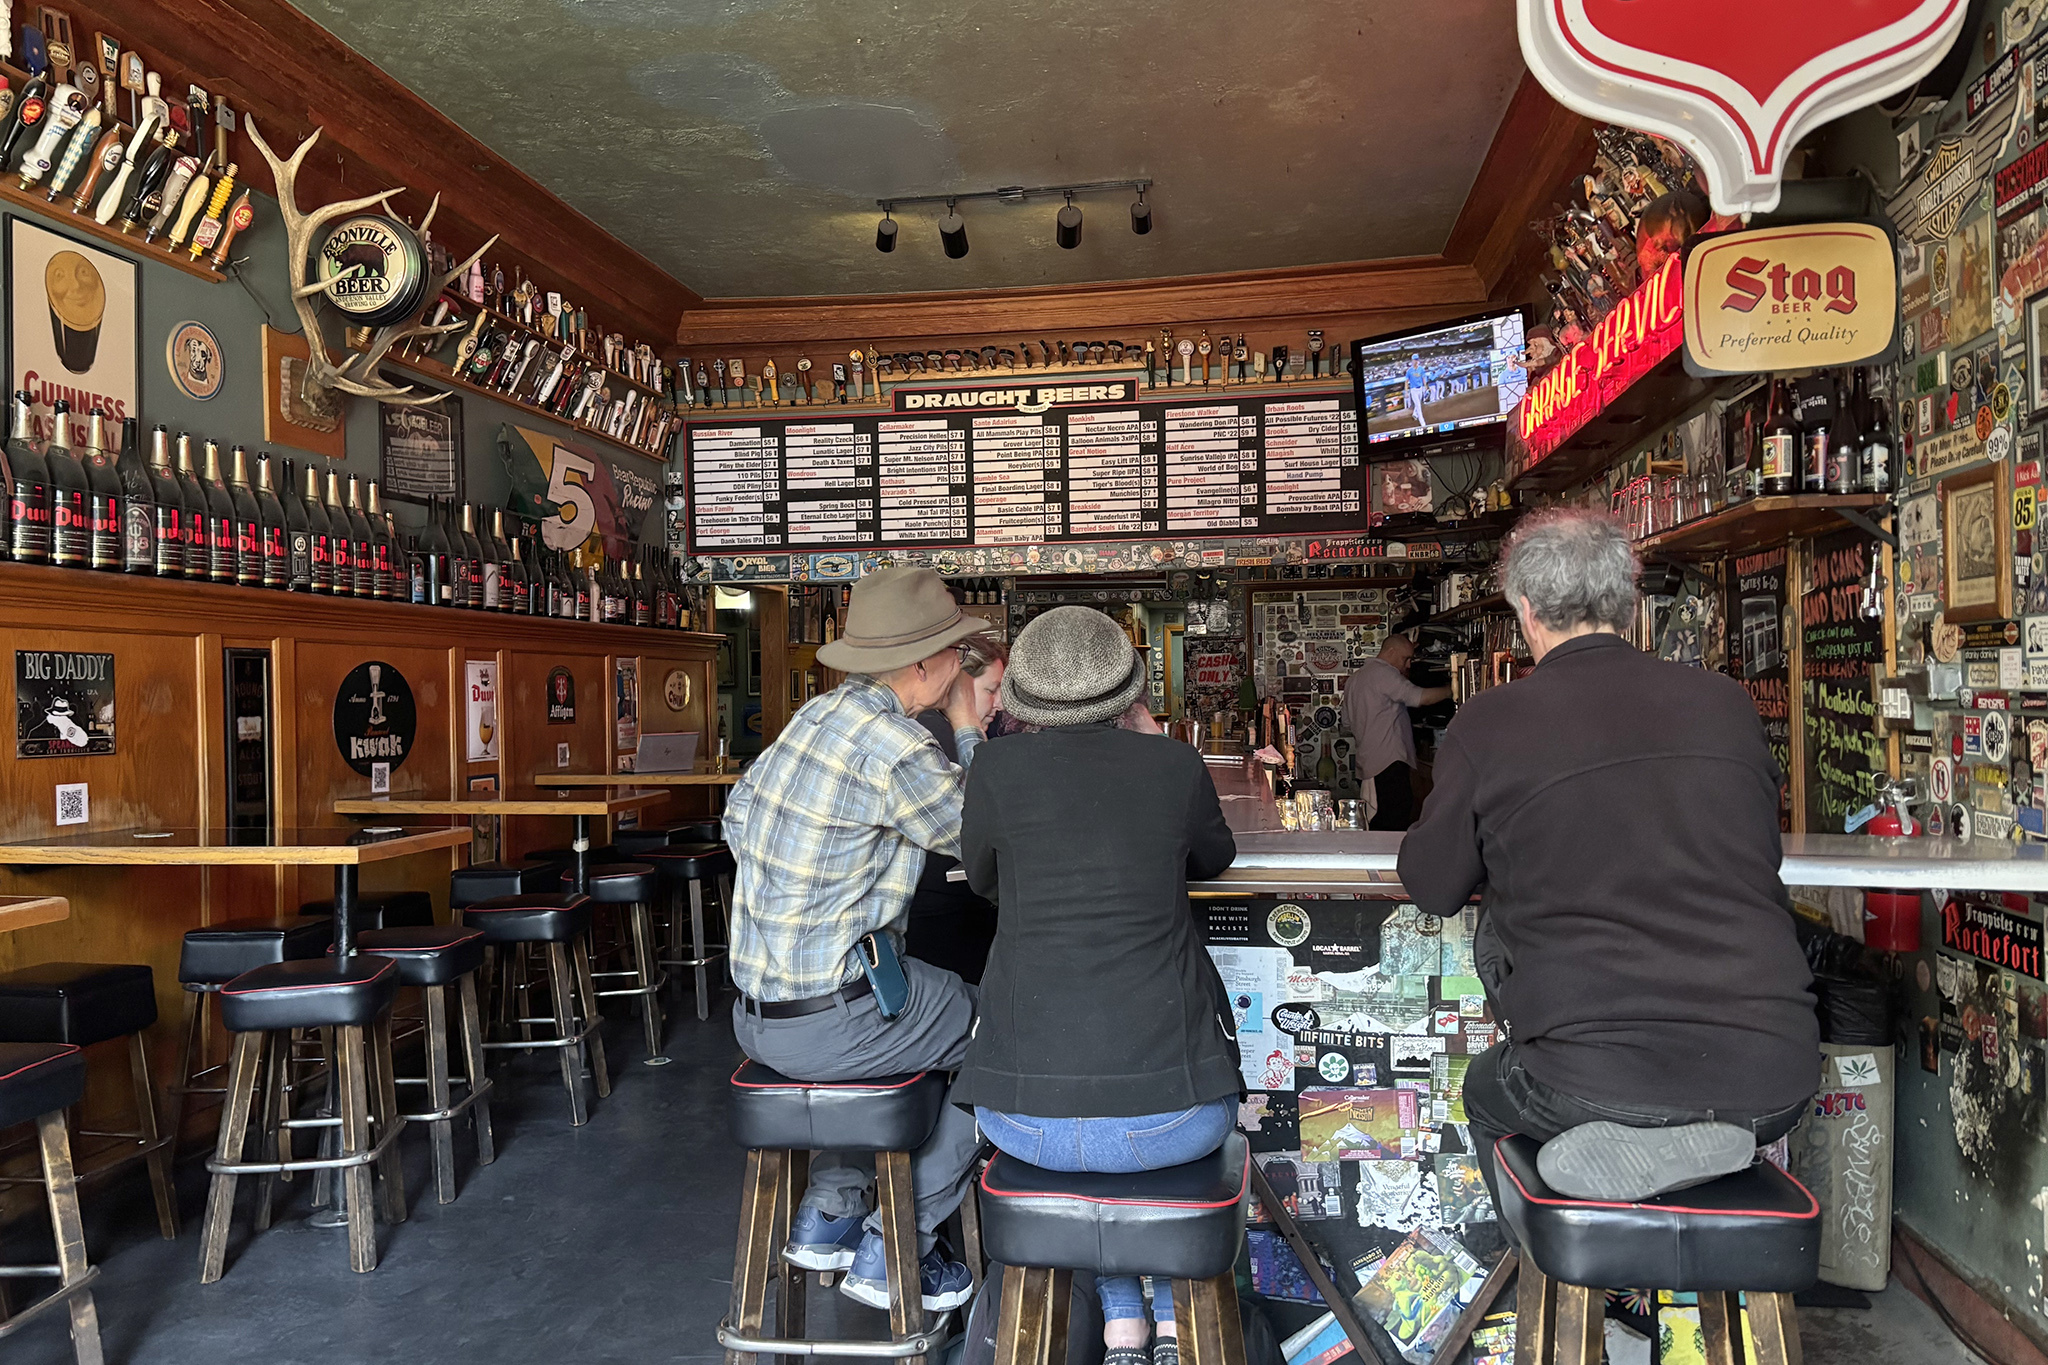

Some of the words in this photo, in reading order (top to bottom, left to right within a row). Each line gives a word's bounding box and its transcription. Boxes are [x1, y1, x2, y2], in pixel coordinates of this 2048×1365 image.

[1929, 148, 1958, 184] MOTOR
[1919, 159, 1972, 220] HARLEY-DAVIDSON
[1931, 197, 1961, 234] CYCLES
[336, 277, 384, 295] BEER
[1719, 256, 1858, 315] Stag
[365, 293, 387, 302] VALLEY
[1771, 302, 1812, 314] BEER
[1520, 341, 1586, 441] GARAGE
[1592, 252, 1684, 381] SERVIC
[1719, 328, 1792, 354] Preferred
[1796, 324, 1859, 345] Quality
[24, 370, 126, 425] GUINNESS
[906, 388, 1031, 408] DRAUGHT
[1037, 383, 1126, 404] BEERS
[1987, 434, 2009, 455] 99%
[541, 442, 596, 552] 5
[2014, 497, 2032, 528] 85
[1308, 541, 1384, 560] Rochefort
[1409, 550, 1429, 559] KNBR
[733, 557, 769, 573] ORVAL
[758, 564, 776, 573] BIER
[1236, 557, 1256, 566] FRESH
[1811, 558, 1829, 588] EW
[1831, 542, 1865, 583] CANS
[1802, 590, 1828, 629] AND
[1806, 627, 1826, 645] CHECK
[1826, 626, 1839, 642] OUT
[1815, 643, 1846, 659] CURRENT
[1848, 642, 1863, 657] LIST
[1864, 641, 1873, 655] AT
[24, 653, 51, 681] BIG
[54, 653, 108, 682] DADDY
[1198, 654, 1231, 668] CASH
[1198, 670, 1230, 683] ONLY
[234, 680, 263, 699] YOUNG
[549, 704, 574, 720] Affligem
[235, 772, 264, 787] STOUT
[1965, 902, 2014, 934] Trappistes
[1312, 944, 1332, 953] LOCAL
[1339, 944, 1362, 953] BARREL
[1944, 901, 2039, 978] Rochefort
[1287, 974, 1320, 984] Metro
[1281, 1018, 1314, 1034] Weight
[1463, 1020, 1496, 1031] Toronado
[1299, 1030, 1352, 1047] INFINITE
[1354, 1034, 1385, 1049] BITS
[1466, 1034, 1489, 1043] YEAST
[1349, 1108, 1375, 1123] NELSON
[1352, 1250, 1376, 1268] ALVARADO
[1421, 1278, 1436, 1294] Hop
